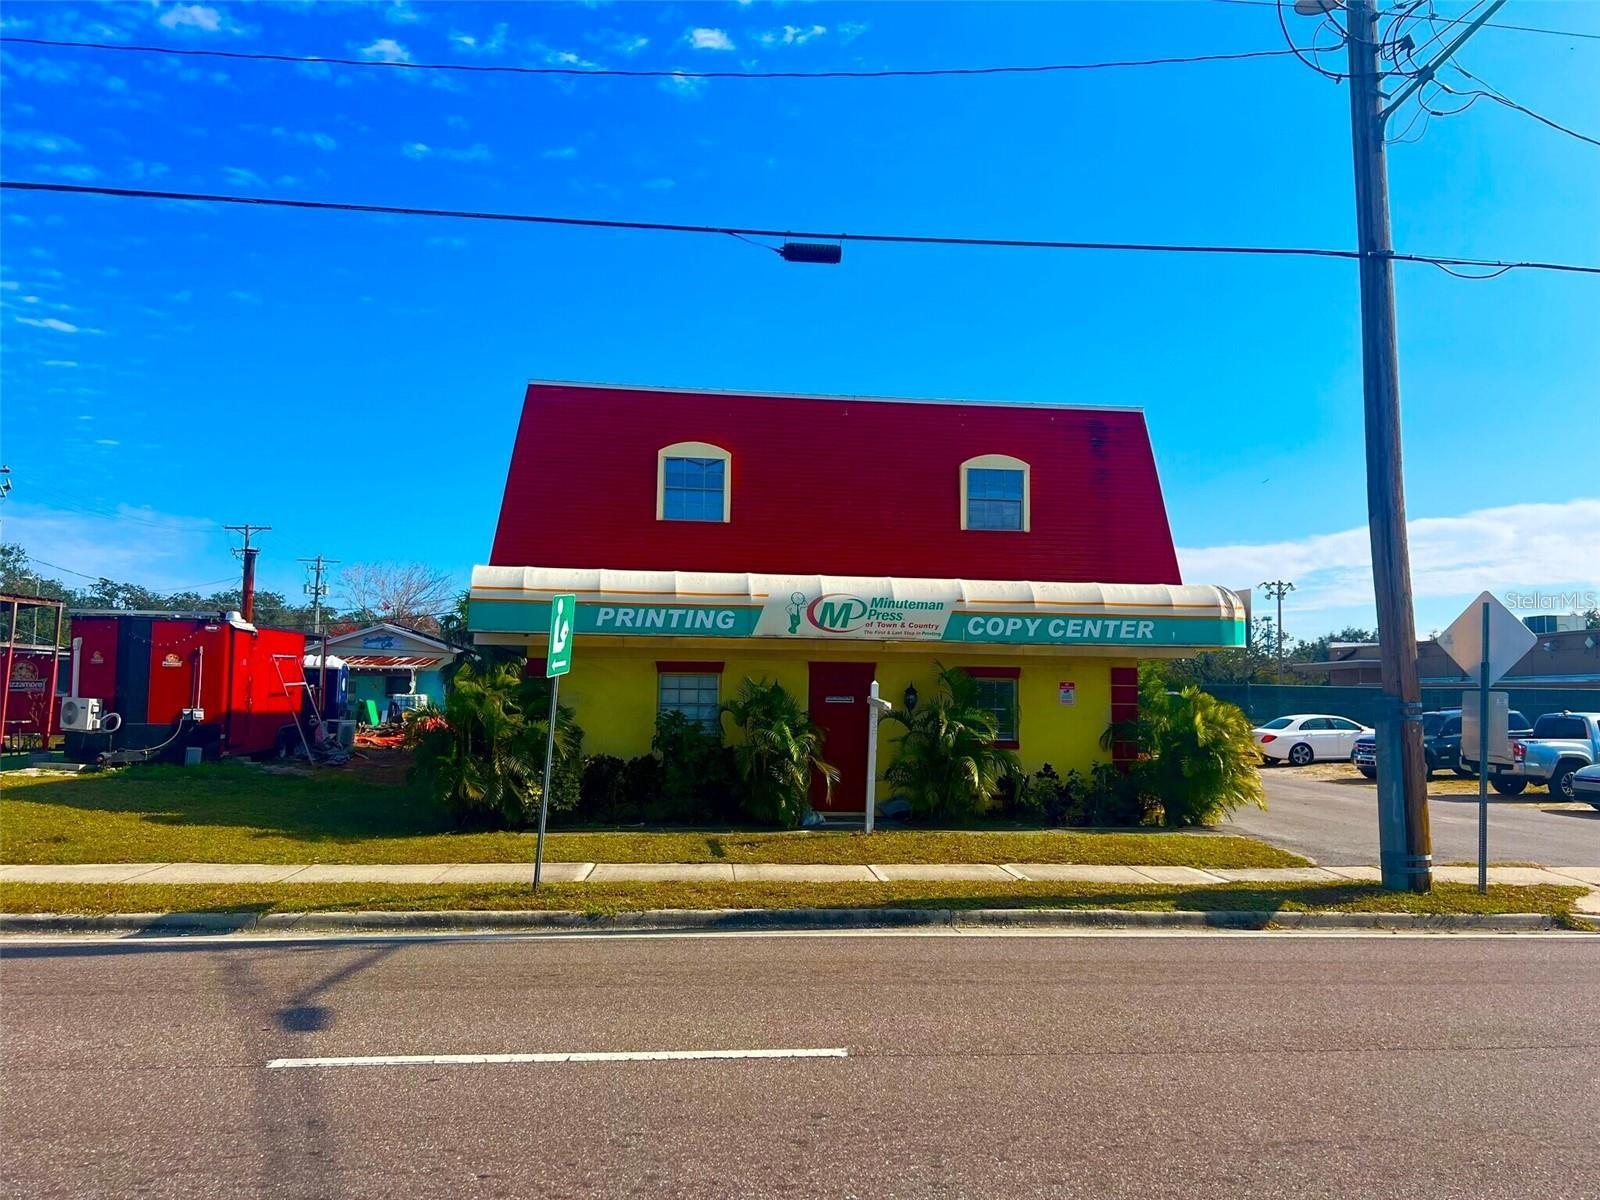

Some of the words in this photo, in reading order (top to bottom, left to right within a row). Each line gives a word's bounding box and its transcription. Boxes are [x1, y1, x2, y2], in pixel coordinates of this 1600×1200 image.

[870, 597, 944, 610] Minuteman
[596, 607, 736, 629] PRINTING
[867, 609, 904, 621] Press
[908, 622, 939, 630] Country
[967, 616, 1042, 637] COPY
[1048, 619, 1155, 639] CENTER
